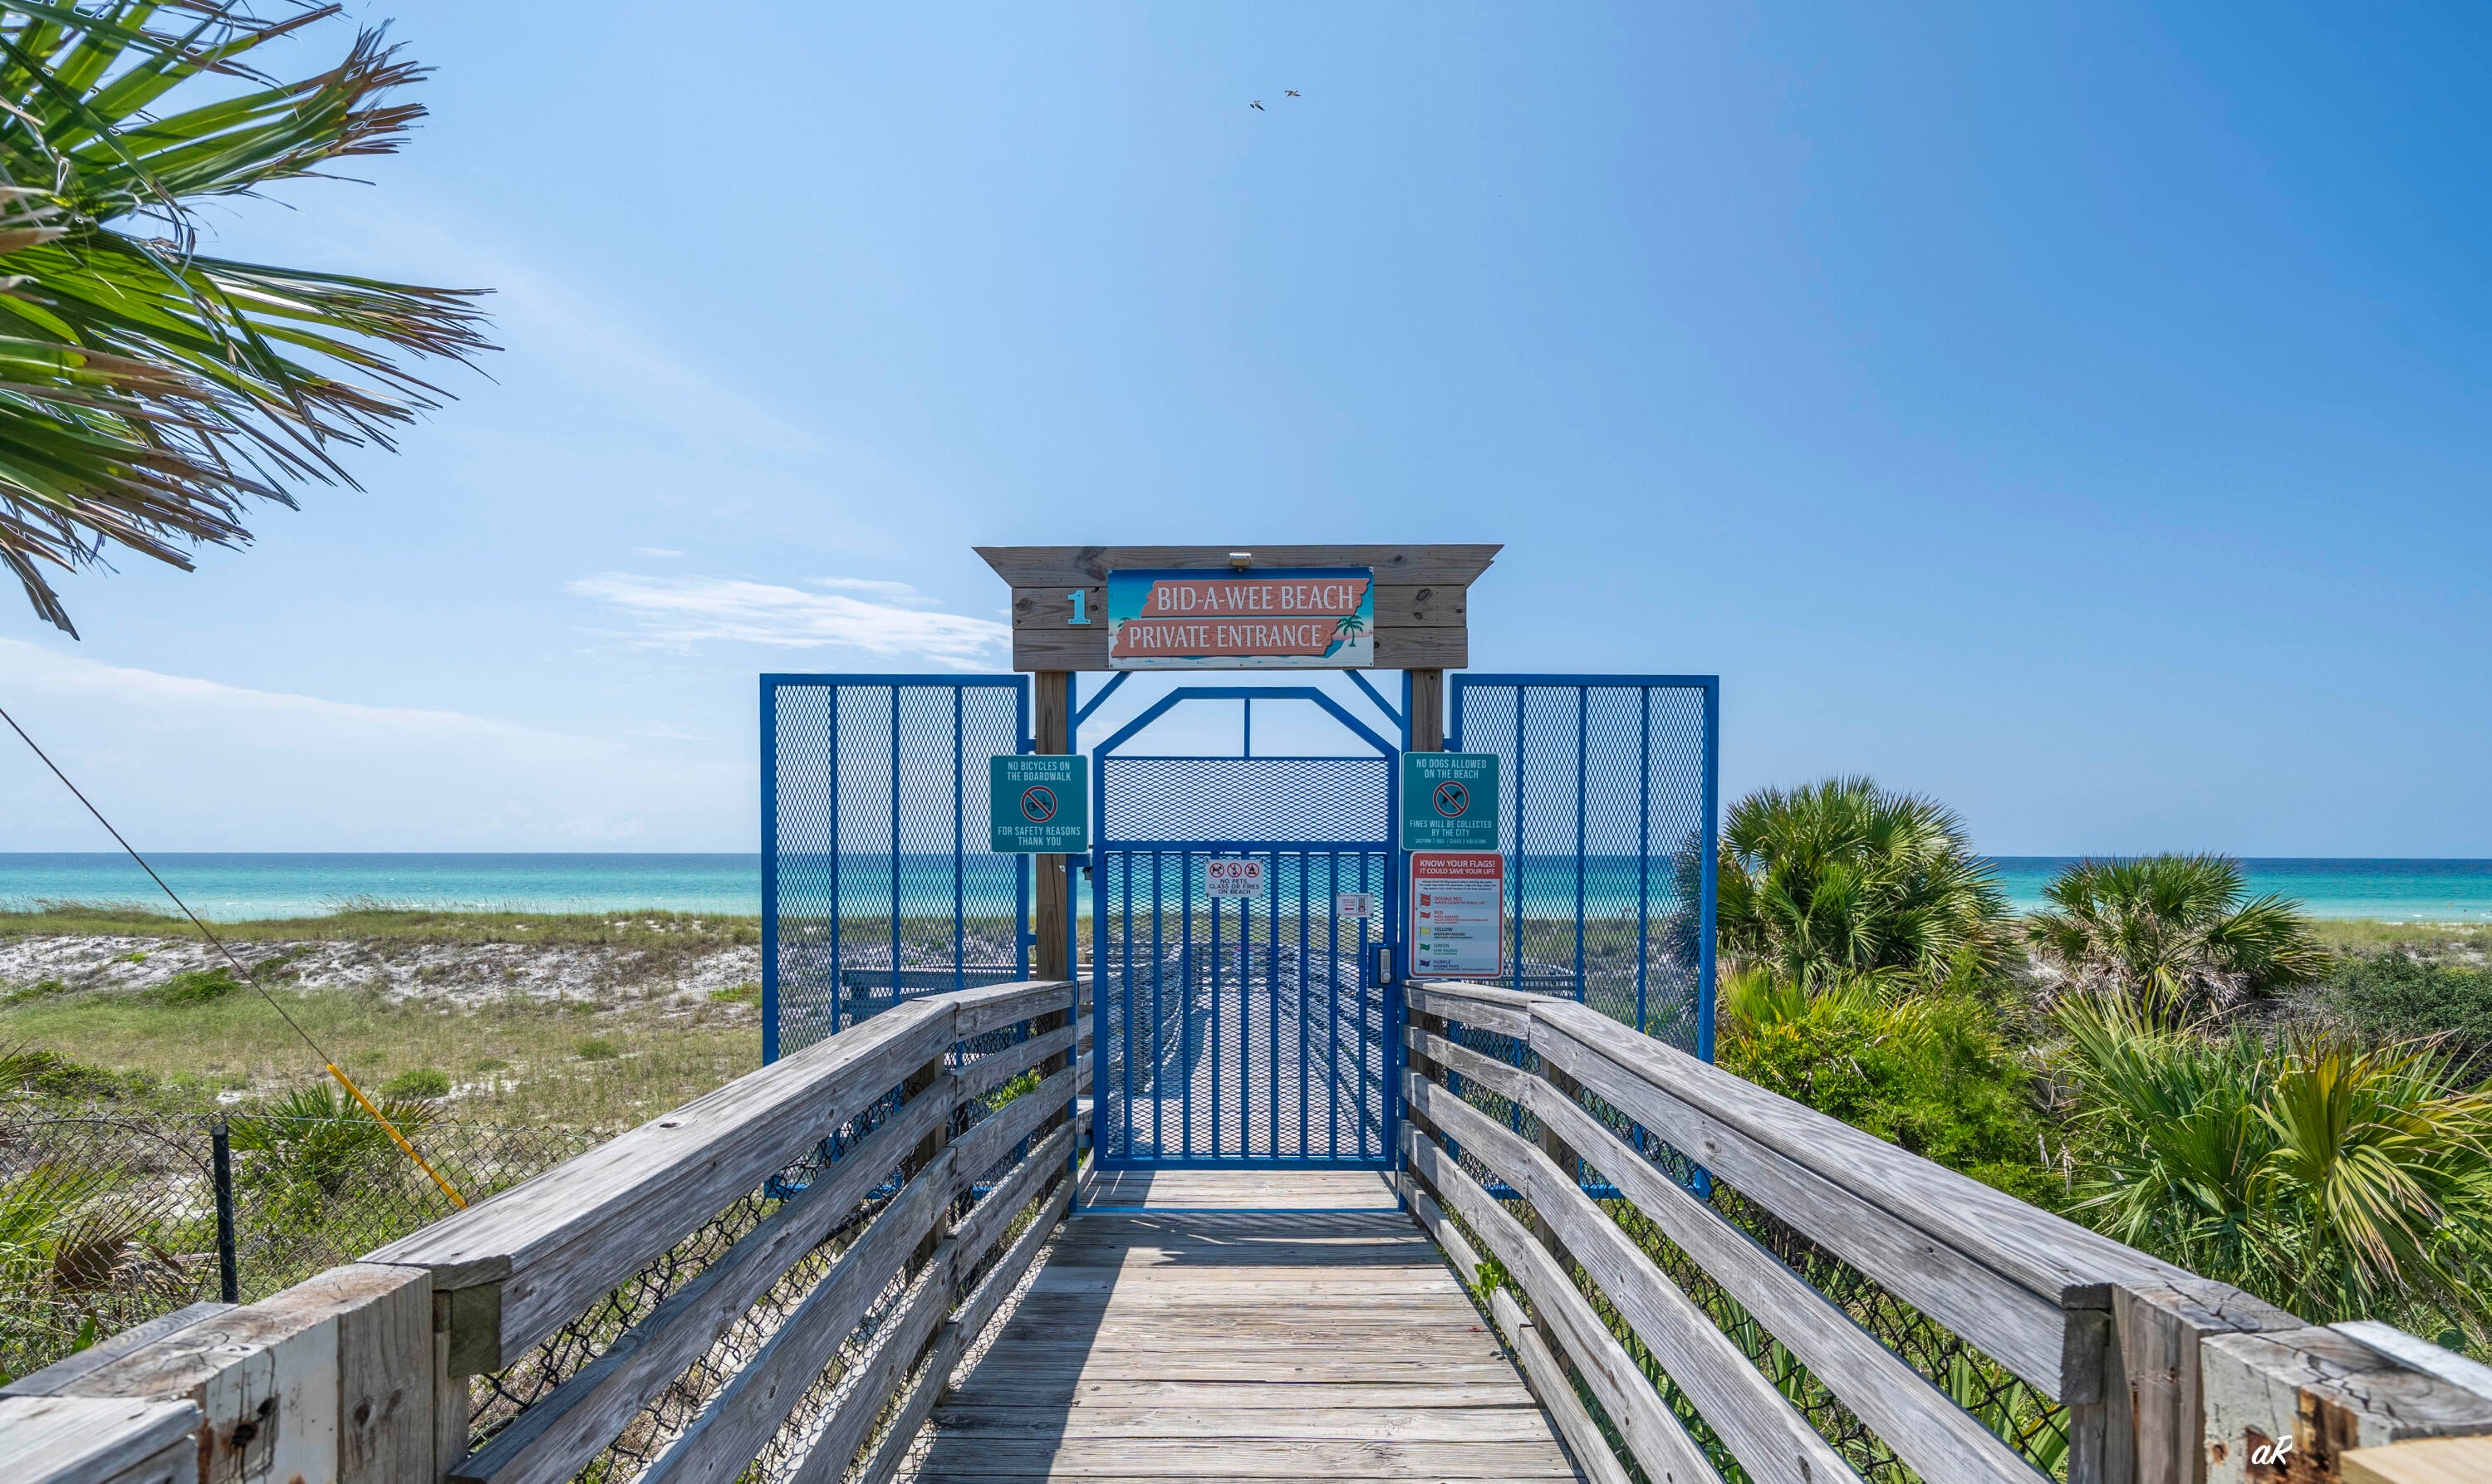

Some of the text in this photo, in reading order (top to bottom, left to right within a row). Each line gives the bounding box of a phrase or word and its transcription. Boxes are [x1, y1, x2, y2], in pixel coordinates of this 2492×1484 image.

[1157, 585, 1354, 610] BID-A-WEE BEACH
[1067, 589, 1091, 624] 1
[1129, 624, 1322, 648] PRIVATE ENTRANCE
[1008, 762, 1070, 771] NO BICYCLES ON
[1416, 759, 1487, 768] NO DOGS ALLOWED
[1007, 772, 1072, 781] THE BOARDWALK
[1424, 770, 1479, 778] ON THE BEACH
[1447, 820, 1454, 828] BE
[998, 826, 1081, 835] FOR SAFETY REASONS
[1018, 836, 1062, 845] THANK YOU
